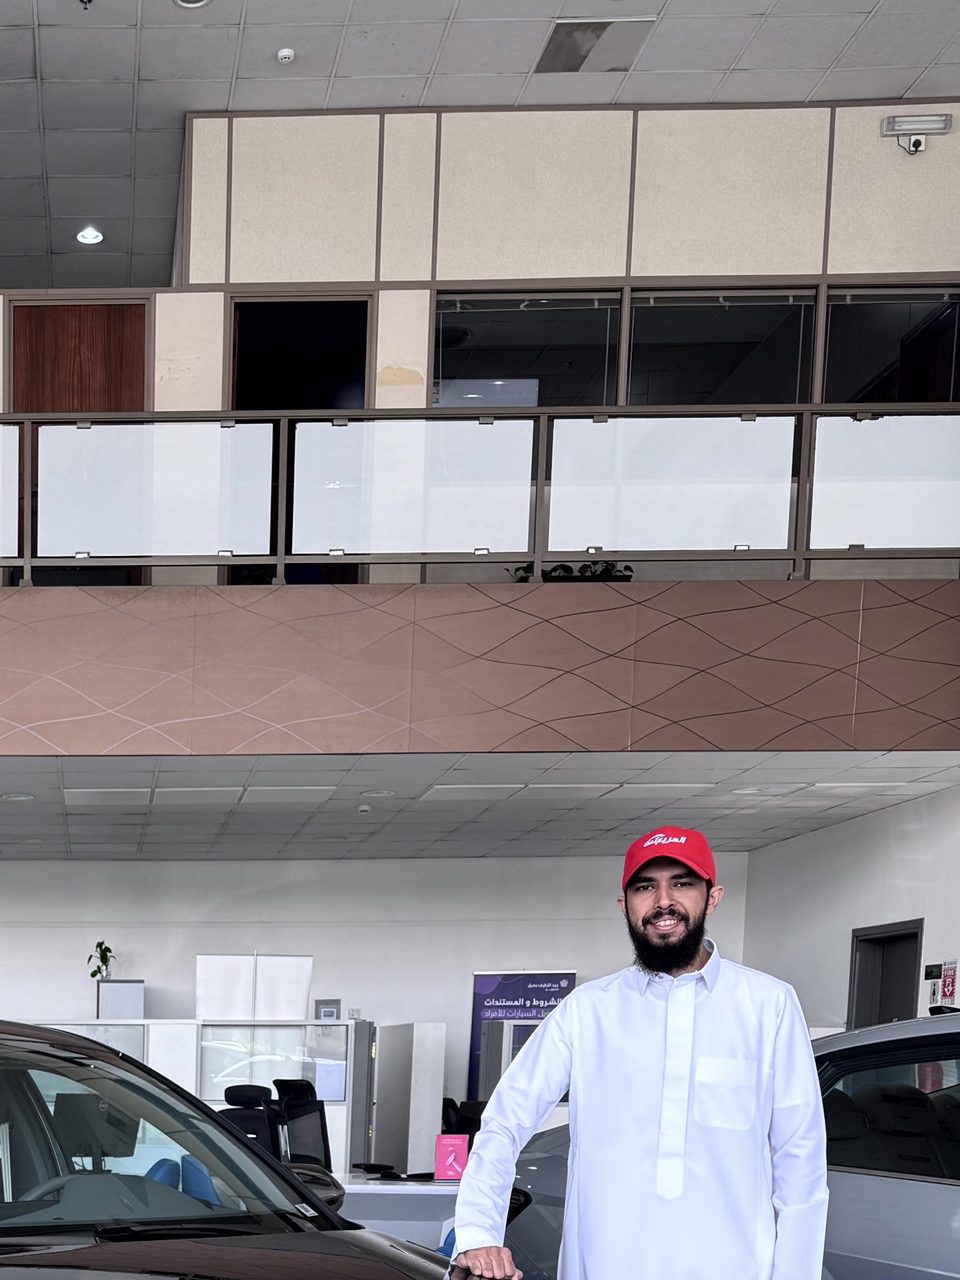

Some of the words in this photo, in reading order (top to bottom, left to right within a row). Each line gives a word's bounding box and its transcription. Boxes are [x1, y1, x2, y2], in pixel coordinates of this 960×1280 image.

[484, 998, 524, 1006] المستندات
[525, 999, 531, 1007] و
[506, 1009, 537, 1018] السيارات
